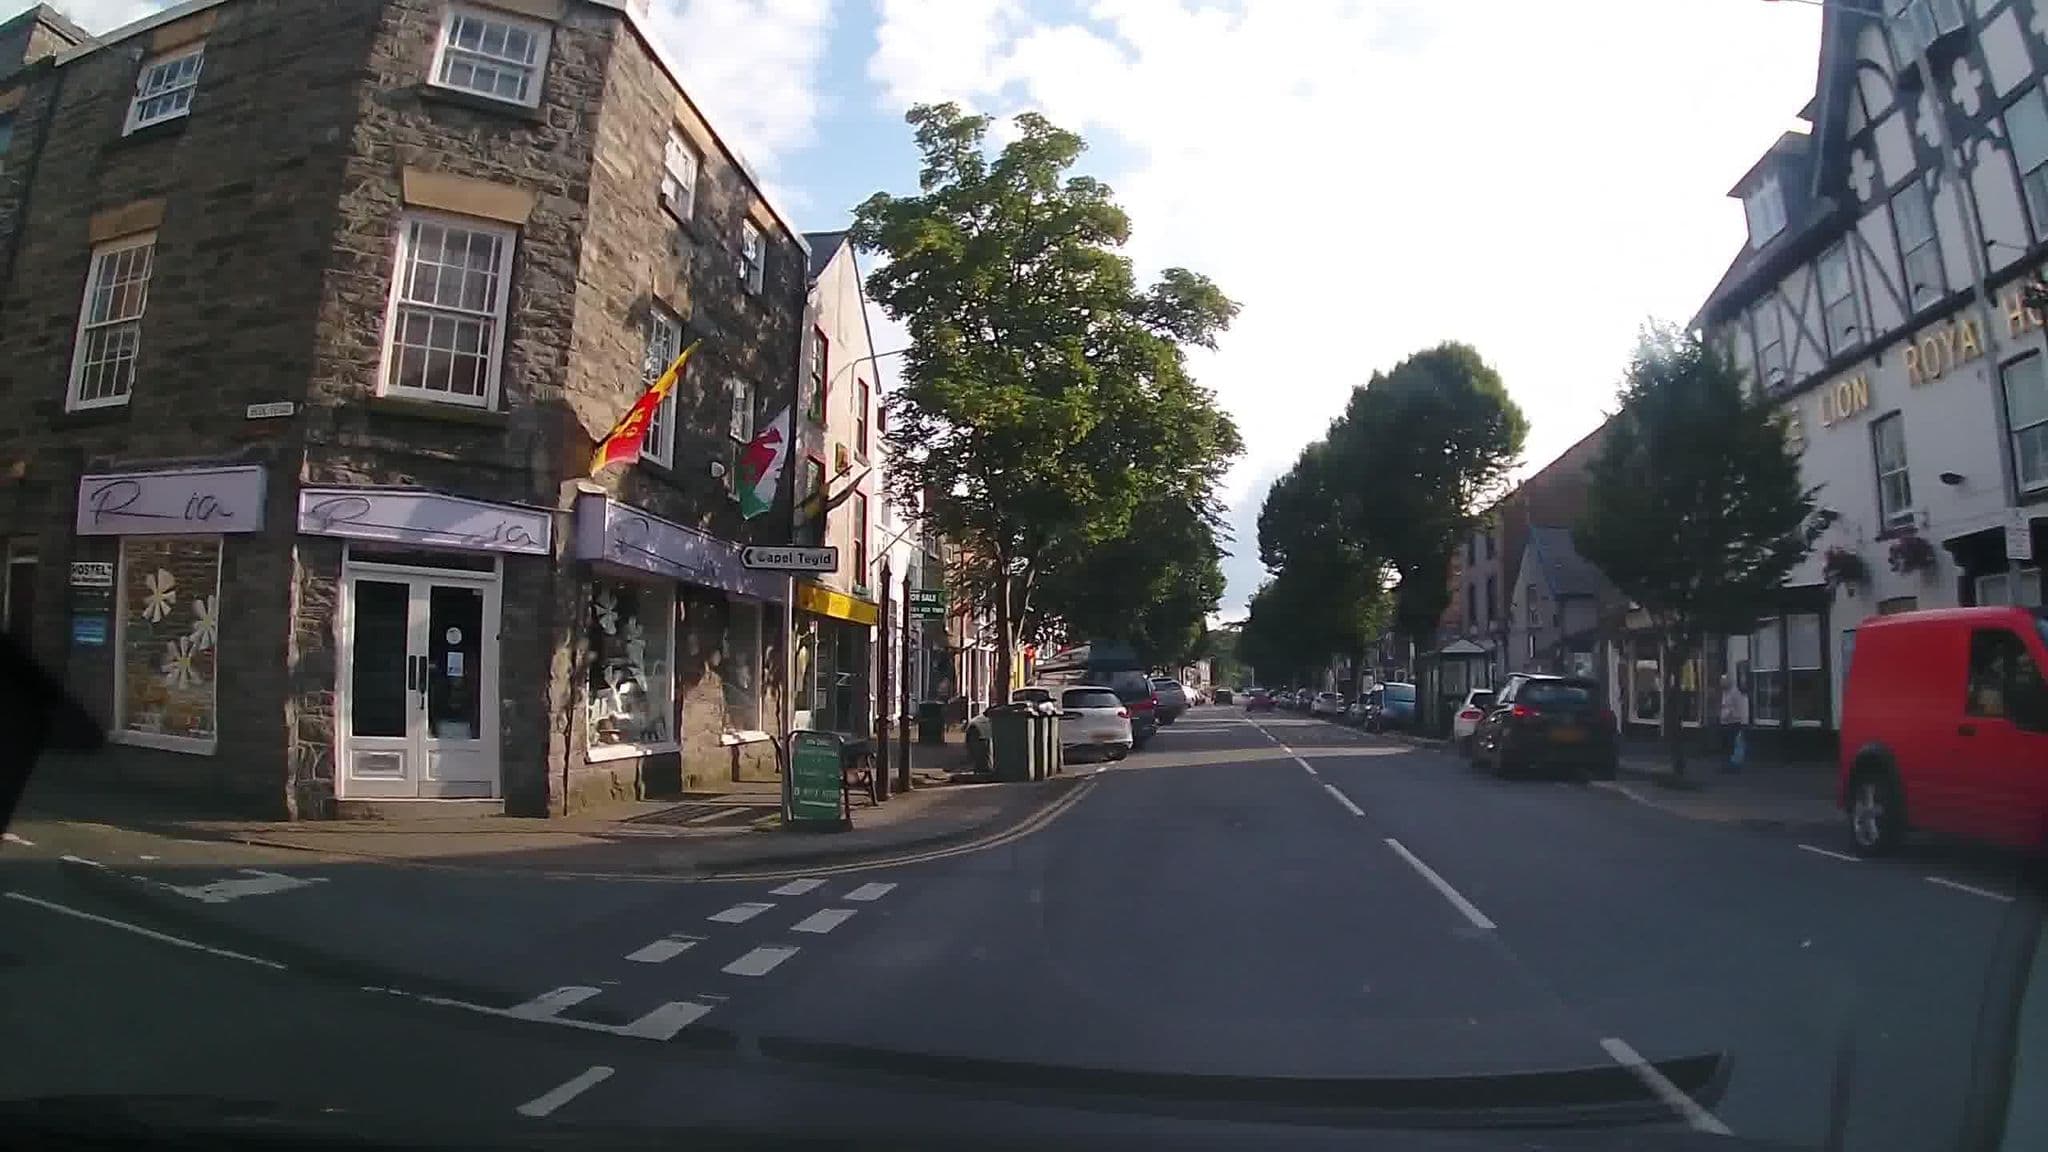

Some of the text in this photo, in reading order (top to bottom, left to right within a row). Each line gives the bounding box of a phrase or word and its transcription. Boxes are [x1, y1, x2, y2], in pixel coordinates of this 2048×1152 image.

[1821, 373, 1869, 429] LION
[1903, 318, 1985, 388] ROYA
[757, 551, 832, 566] Capel Tegid
